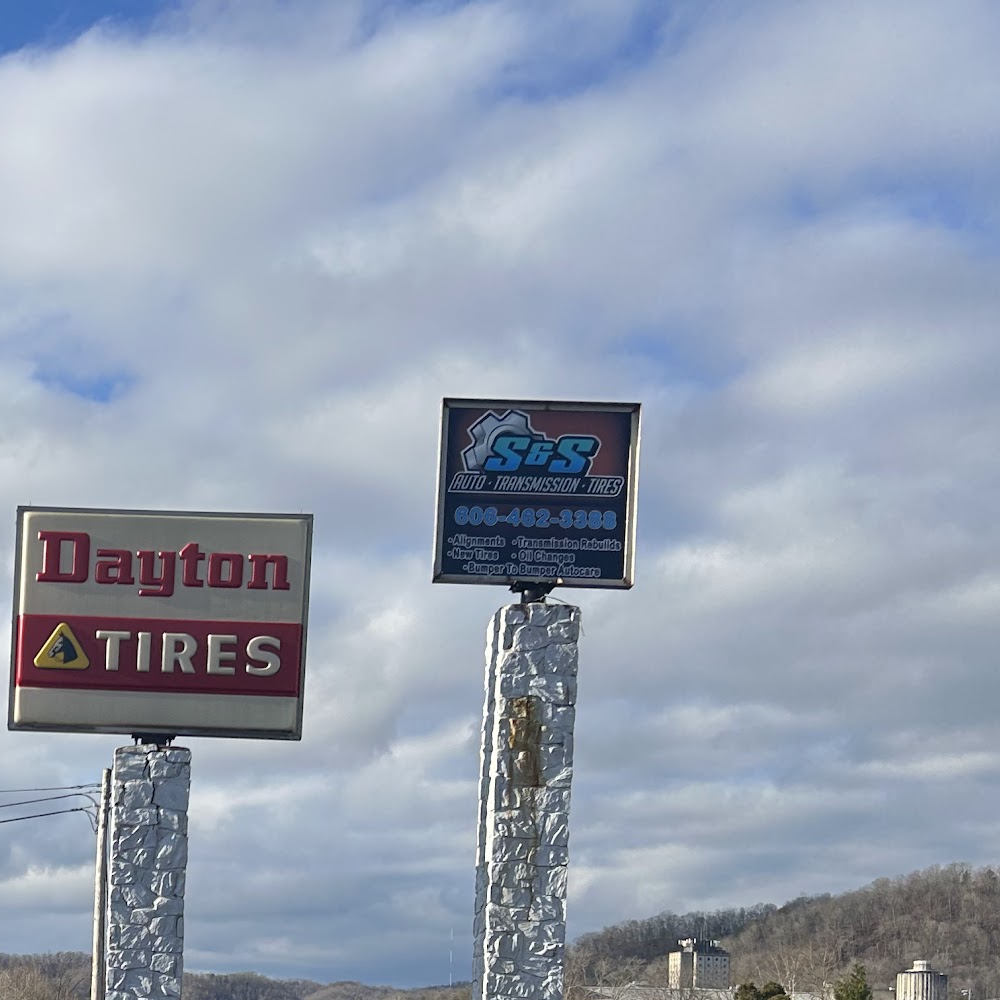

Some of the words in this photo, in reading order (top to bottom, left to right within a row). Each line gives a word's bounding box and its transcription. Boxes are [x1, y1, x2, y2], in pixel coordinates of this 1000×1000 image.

[452, 474, 487, 490] AUTO
[493, 476, 582, 493] TRANSMISSION
[586, 478, 622, 494] TIRES
[454, 505, 617, 530] 606-462-3388
[453, 533, 506, 549] Alignments
[516, 536, 579, 550] Transmission
[580, 538, 622, 551] Rebuilds
[452, 547, 474, 560] New
[474, 548, 499, 561] Tires
[518, 549, 533, 562] Oil
[534, 550, 575, 565] Changes
[35, 530, 291, 597] Dayton
[467, 561, 505, 576] Bumper
[505, 562, 518, 575] To
[519, 563, 557, 577] Bumper
[557, 564, 601, 578] Autocare
[96, 630, 281, 676] TIRES
